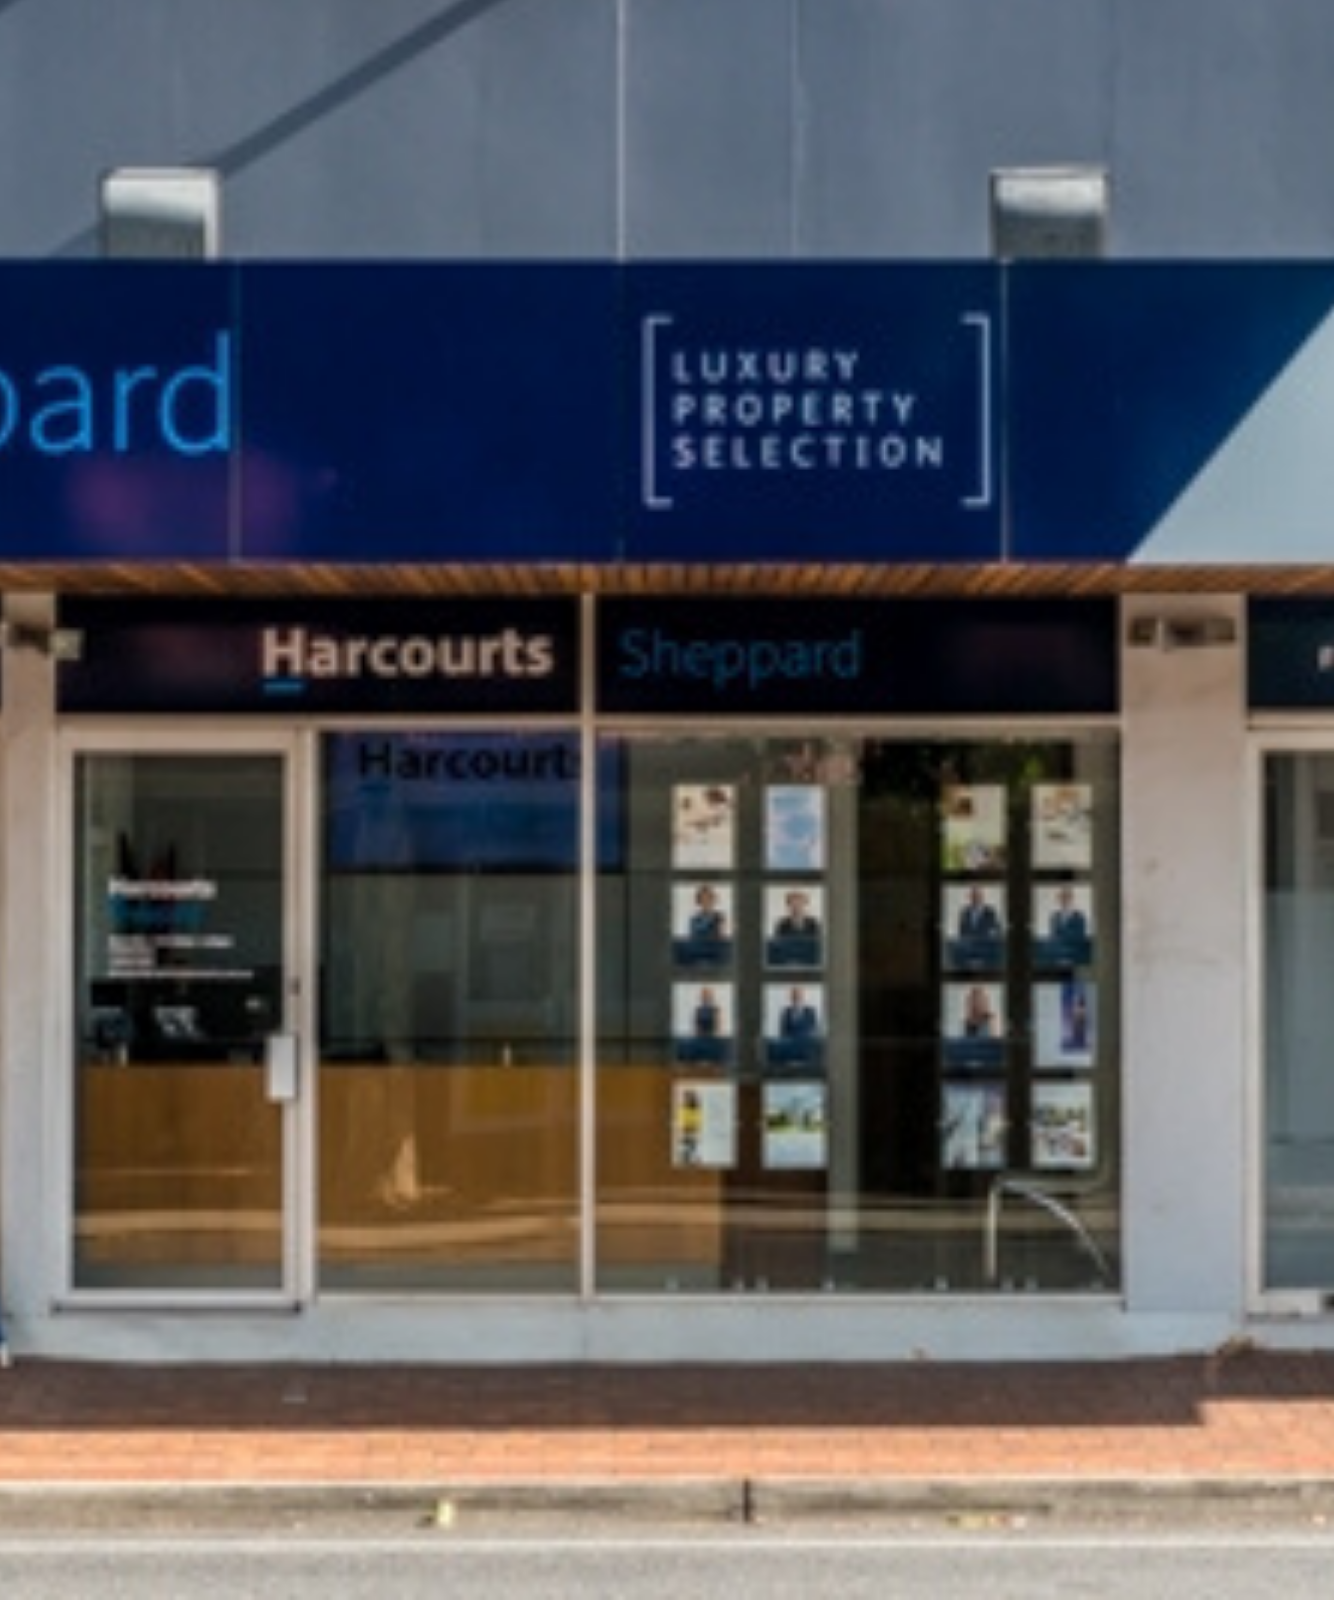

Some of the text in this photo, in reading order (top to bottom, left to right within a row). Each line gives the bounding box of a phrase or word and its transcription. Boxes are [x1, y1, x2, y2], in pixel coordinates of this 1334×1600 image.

[670, 350, 860, 384] LUXURY
[671, 391, 916, 426] PROPERTY
[670, 435, 945, 470] SELECTION
[260, 626, 862, 687] Harcourts Sheppard
